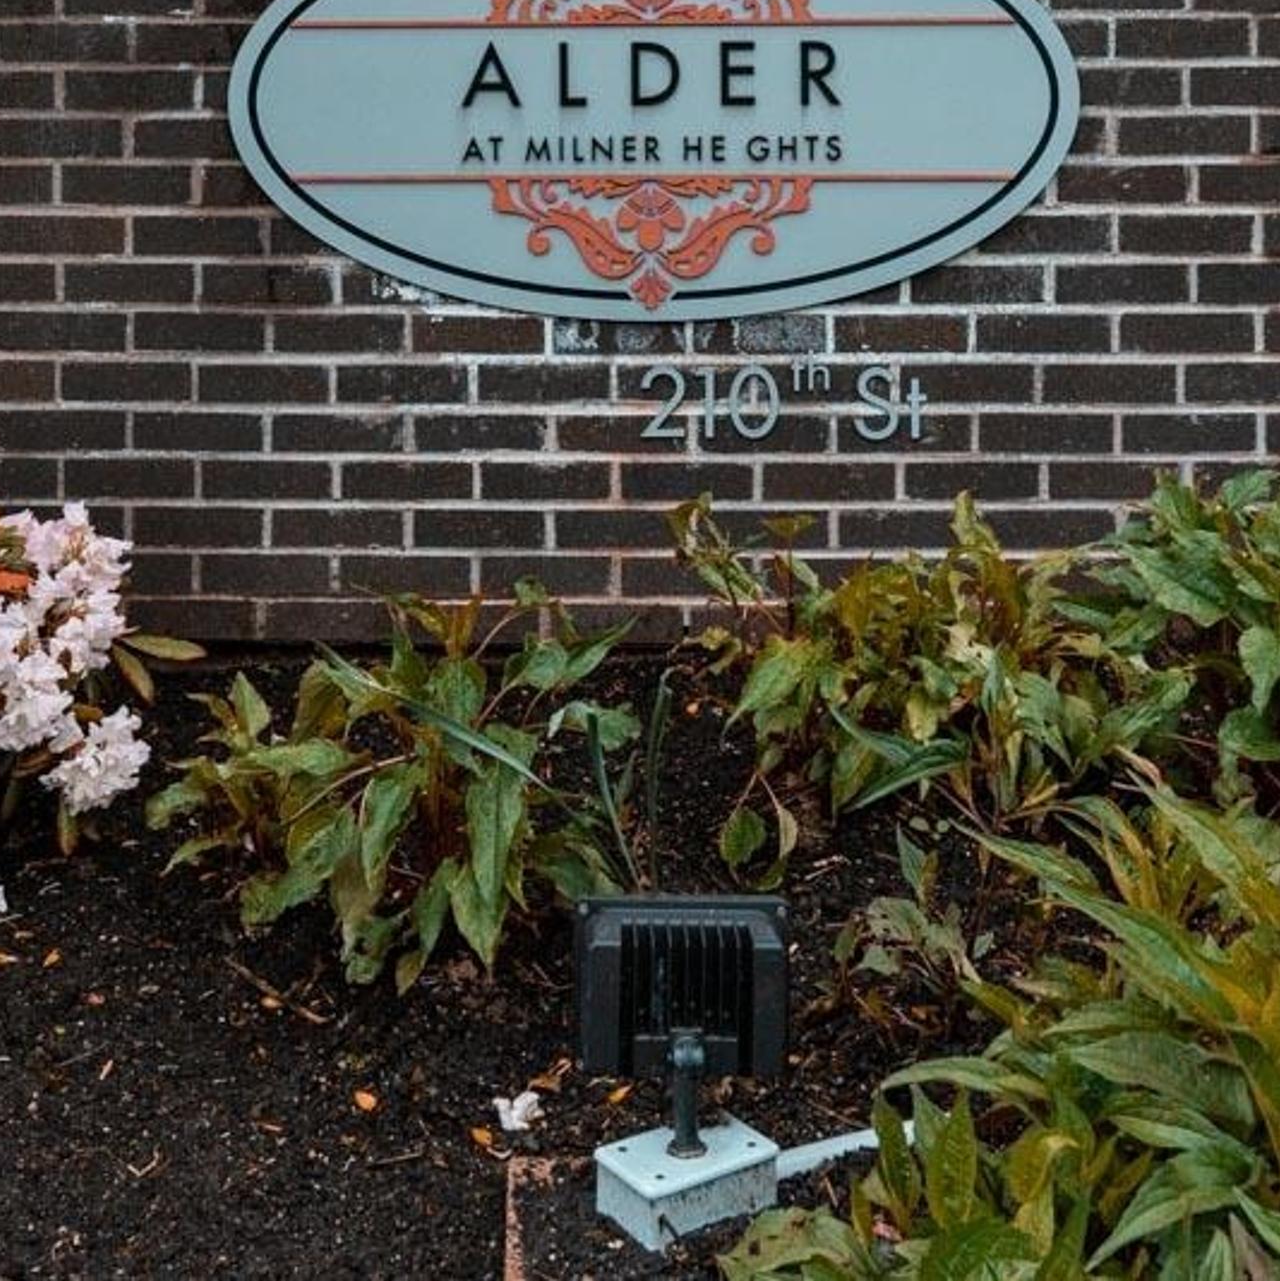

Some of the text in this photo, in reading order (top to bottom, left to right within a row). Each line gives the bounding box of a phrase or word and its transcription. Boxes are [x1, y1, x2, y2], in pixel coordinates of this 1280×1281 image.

[461, 40, 842, 108] ALDER
[461, 135, 843, 163] AT MILNER HEGHTS
[853, 366, 928, 441] St
